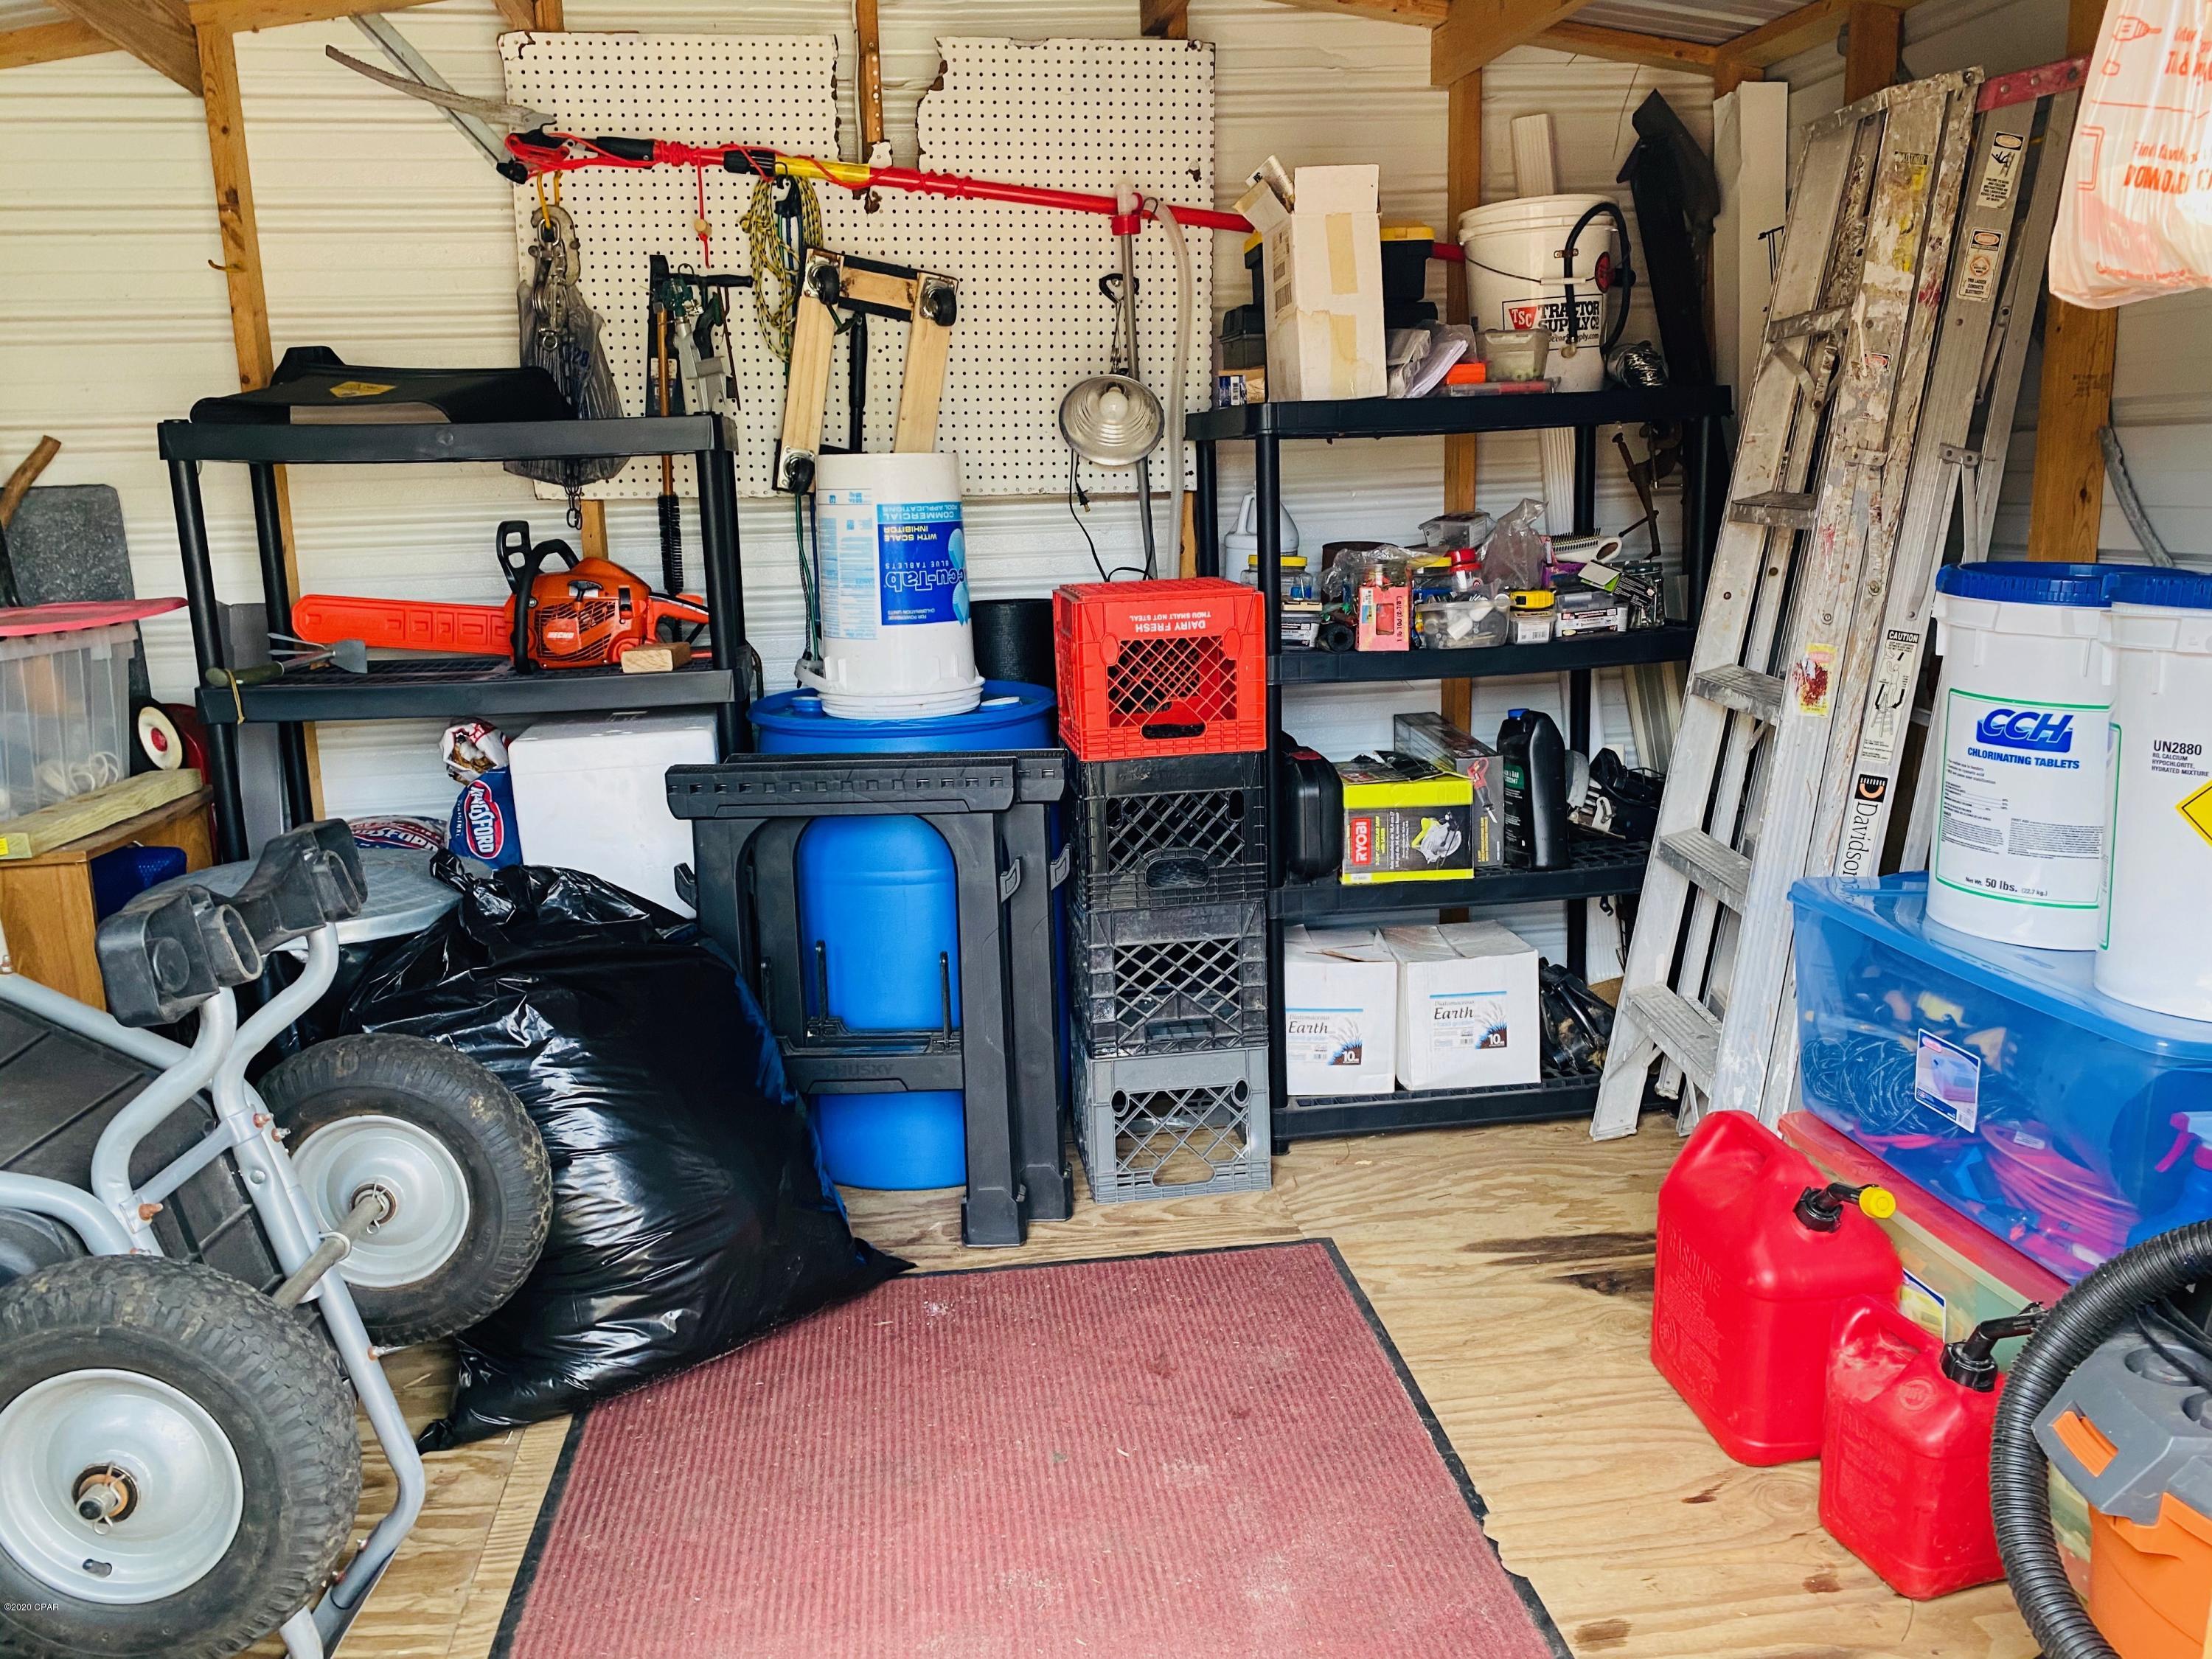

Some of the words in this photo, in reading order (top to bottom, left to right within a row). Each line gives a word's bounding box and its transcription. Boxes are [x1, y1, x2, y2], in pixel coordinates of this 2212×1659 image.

[1512, 309, 1532, 327] TSC
[1537, 300, 1600, 319] TRATOR
[883, 511, 954, 521] COMMERCIAL
[883, 534, 914, 542] SCALE
[917, 533, 937, 541] WITH
[886, 568, 965, 593] ccu-Tab
[1135, 622, 1171, 633] FRESH
[1175, 620, 1206, 631] DAIRY
[1888, 631, 1919, 643] CAUTION
[1983, 709, 2073, 743] CCH
[2153, 739, 2202, 756] UN2880
[1967, 747, 2031, 765] CHLORINATING
[2034, 757, 2080, 770] TABLETS
[2162, 754, 2188, 762] CALCIUM
[2152, 765, 2180, 774] HYDRATED
[2181, 769, 2210, 777] MIXTURE
[469, 786, 496, 854] KINGSFORD
[1356, 821, 1368, 863] RYOBI
[1986, 877, 1997, 888] 50
[2000, 880, 2017, 892] lbs.
[1434, 1006, 1473, 1020] Earth
[1288, 1020, 1328, 1034] Earth
[1488, 1033, 1500, 1045] 10
[1342, 1051, 1356, 1062] 10
